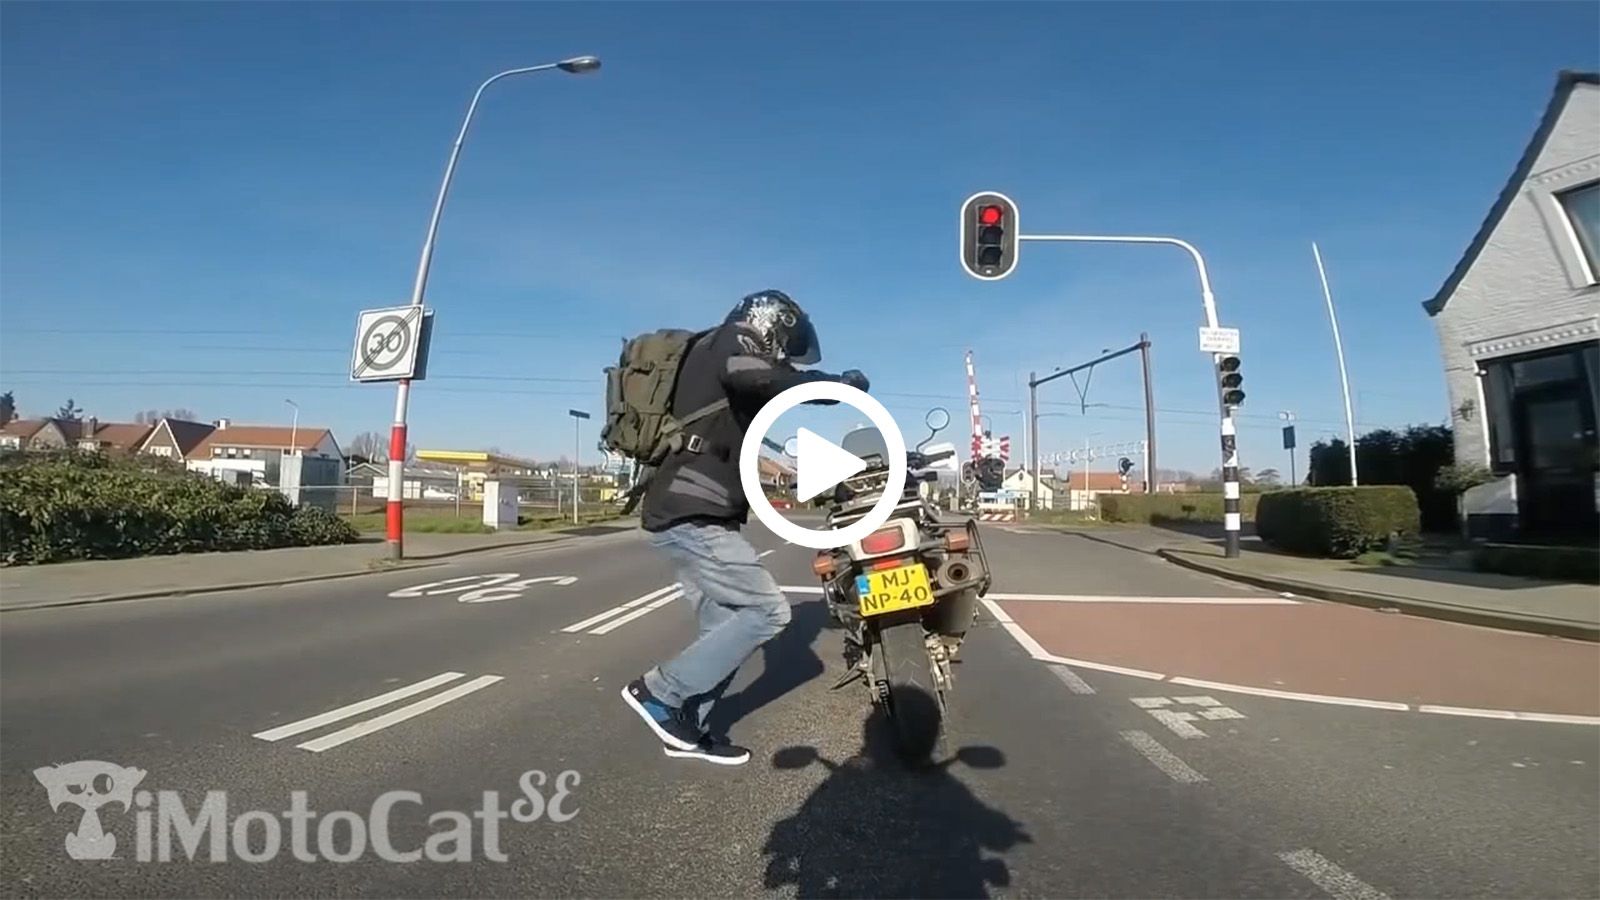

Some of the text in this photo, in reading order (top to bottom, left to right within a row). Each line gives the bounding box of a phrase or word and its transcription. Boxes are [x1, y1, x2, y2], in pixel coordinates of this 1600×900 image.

[369, 331, 402, 354] 30
[388, 572, 579, 604] 30
[863, 586, 928, 612] NP-40
